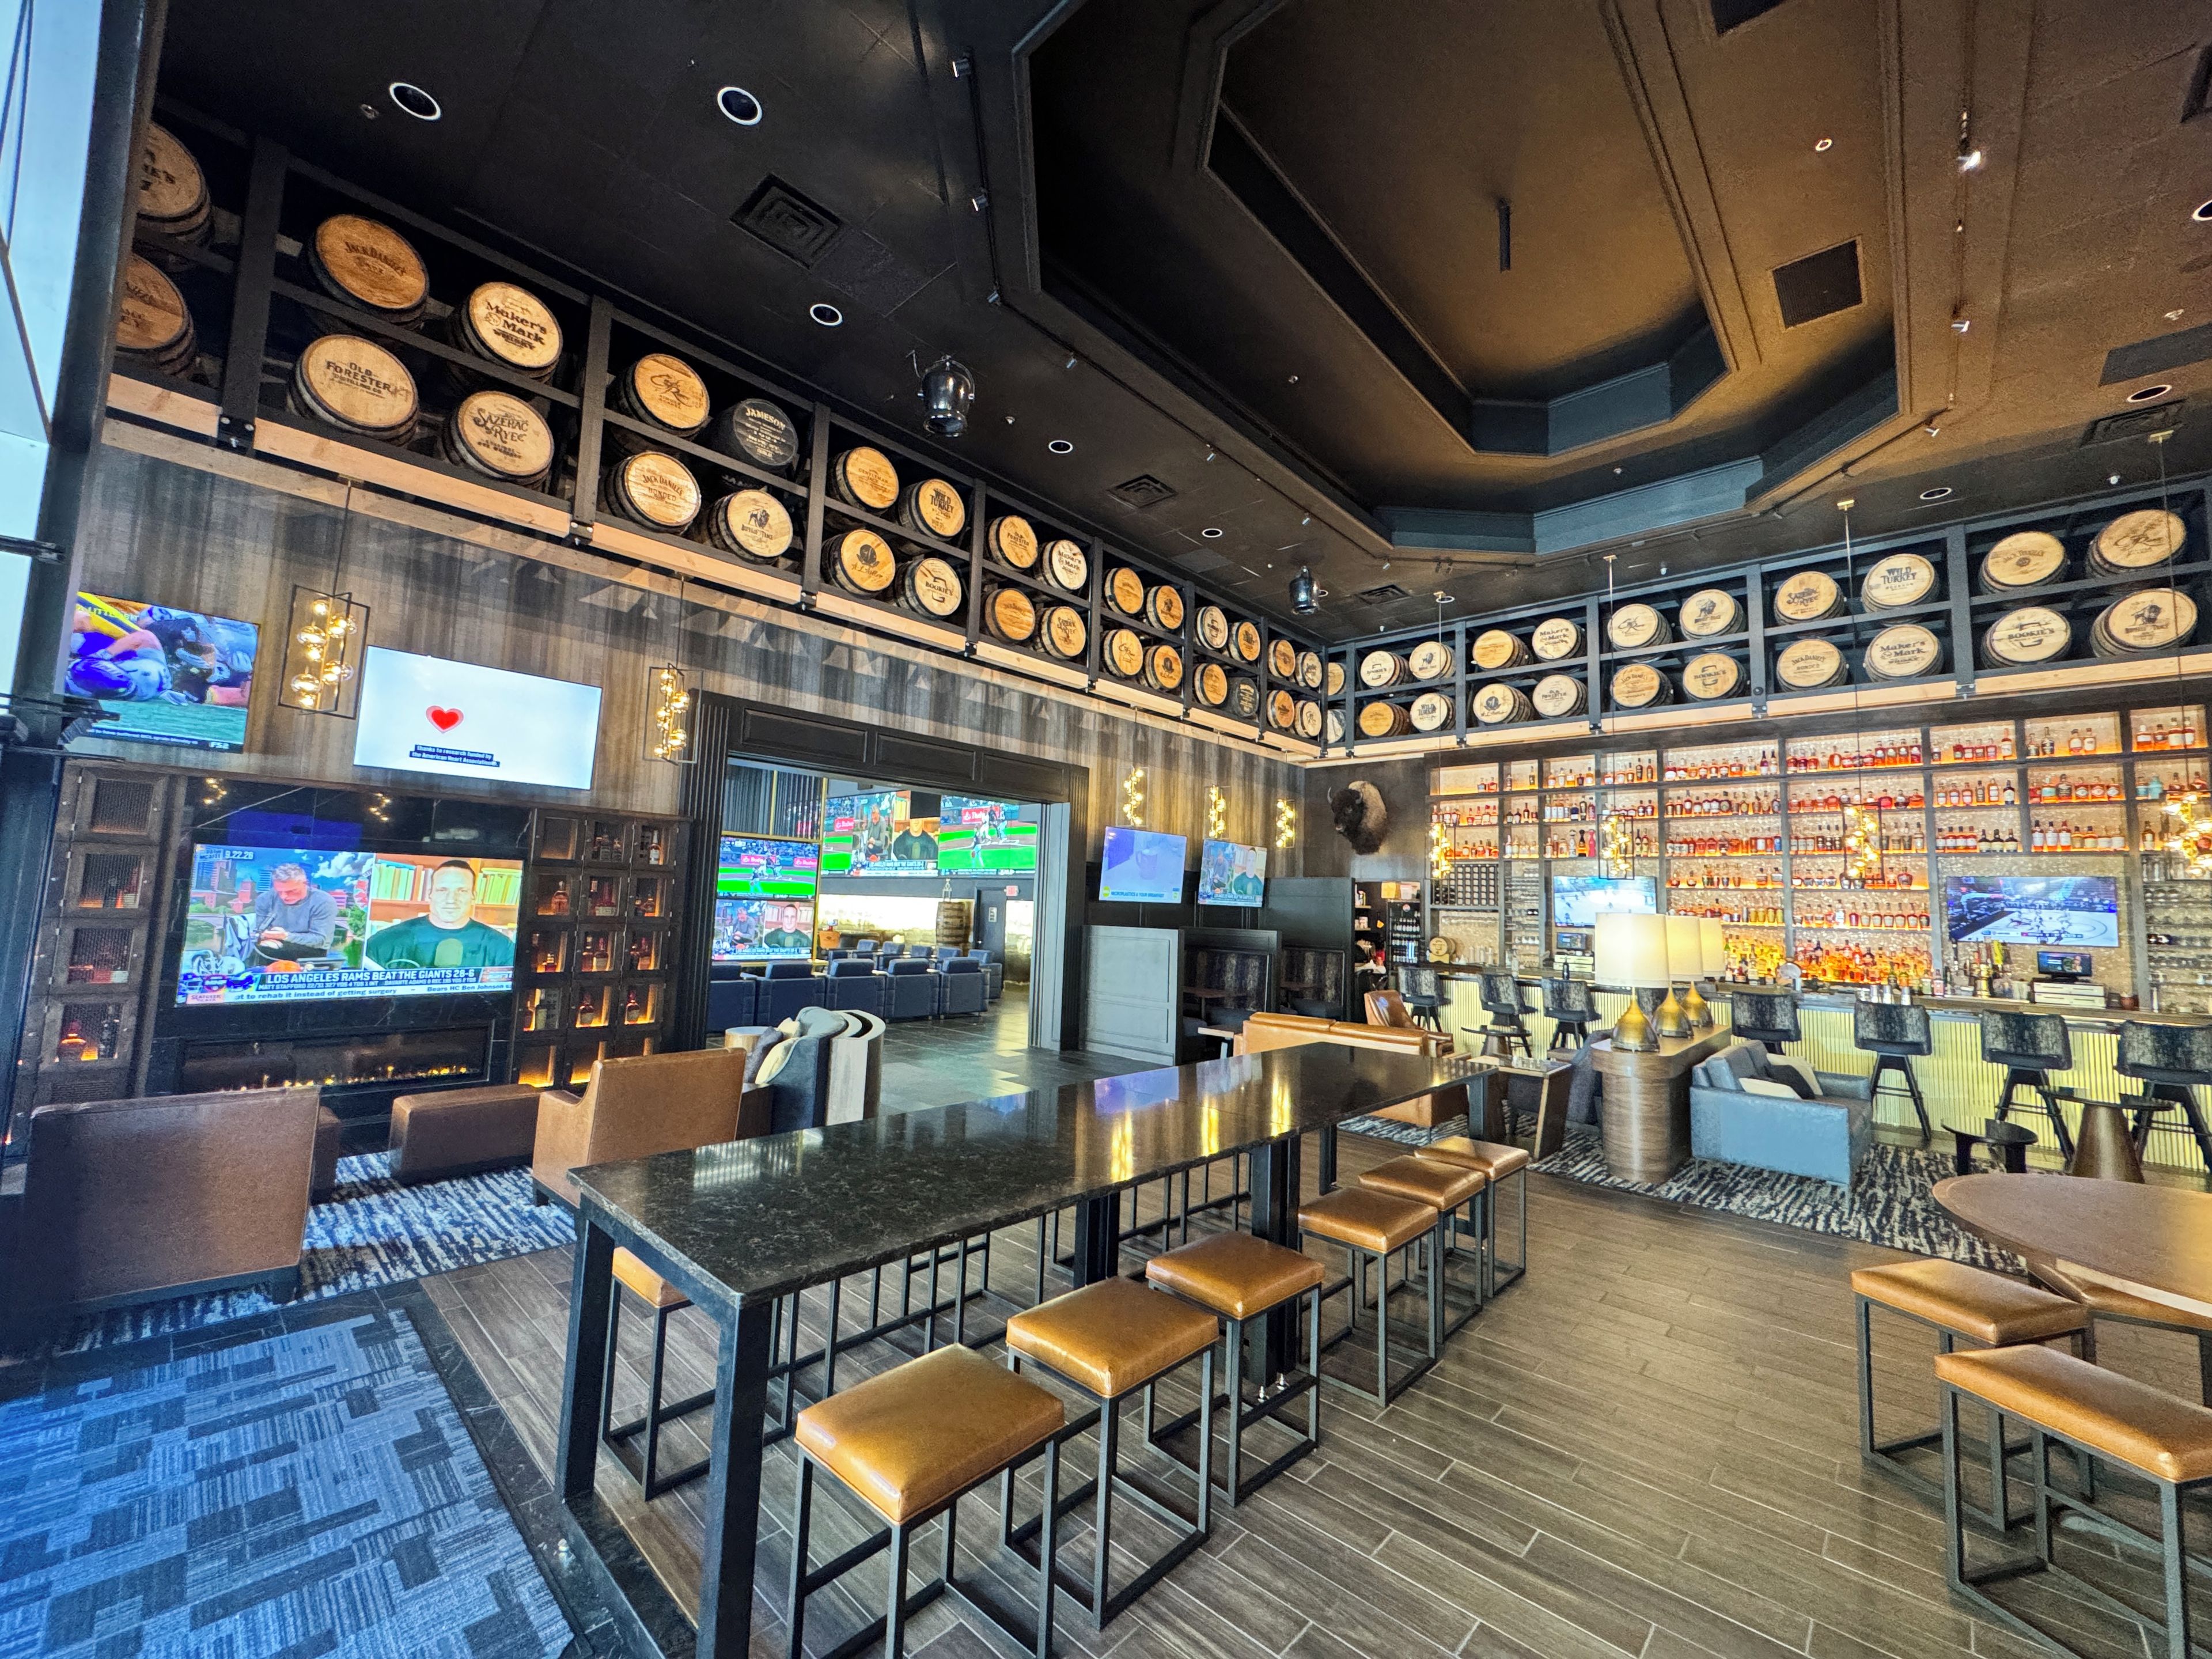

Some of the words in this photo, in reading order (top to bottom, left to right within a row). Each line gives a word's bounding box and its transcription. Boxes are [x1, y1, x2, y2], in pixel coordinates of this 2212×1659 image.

[486, 298, 547, 335] Maker's
[502, 319, 546, 346] Mark
[325, 360, 393, 394] FORESTER
[349, 362, 373, 377] OLD
[745, 407, 786, 431] JAMESON
[1880, 572, 1917, 585] TURKEY
[1886, 566, 1912, 577] WILD
[1879, 641, 1926, 652] Maker's
[1893, 647, 1925, 657] Mark
[267, 974, 290, 984] LOS
[290, 972, 340, 983] ANGELES
[341, 972, 371, 982] RAMS
[372, 971, 398, 980] BEAT
[398, 971, 417, 979] THE
[418, 969, 453, 979] GIANTS
